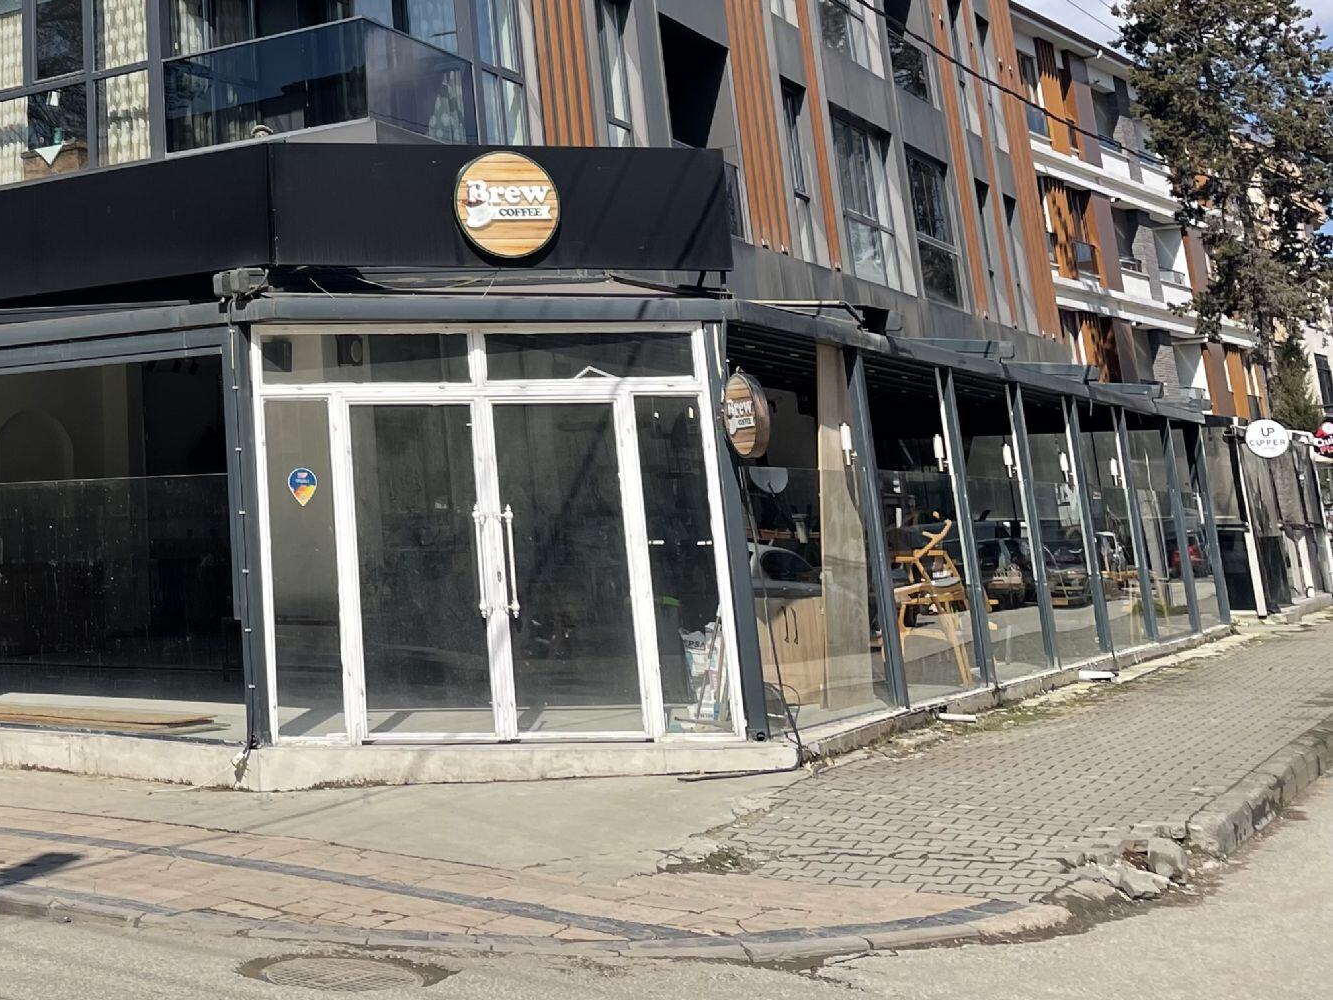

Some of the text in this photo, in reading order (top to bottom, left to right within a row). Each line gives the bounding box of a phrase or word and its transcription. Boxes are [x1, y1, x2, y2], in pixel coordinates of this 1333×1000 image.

[466, 180, 551, 204] Brew
[499, 208, 542, 217] COFFEE
[726, 399, 753, 416] Brew
